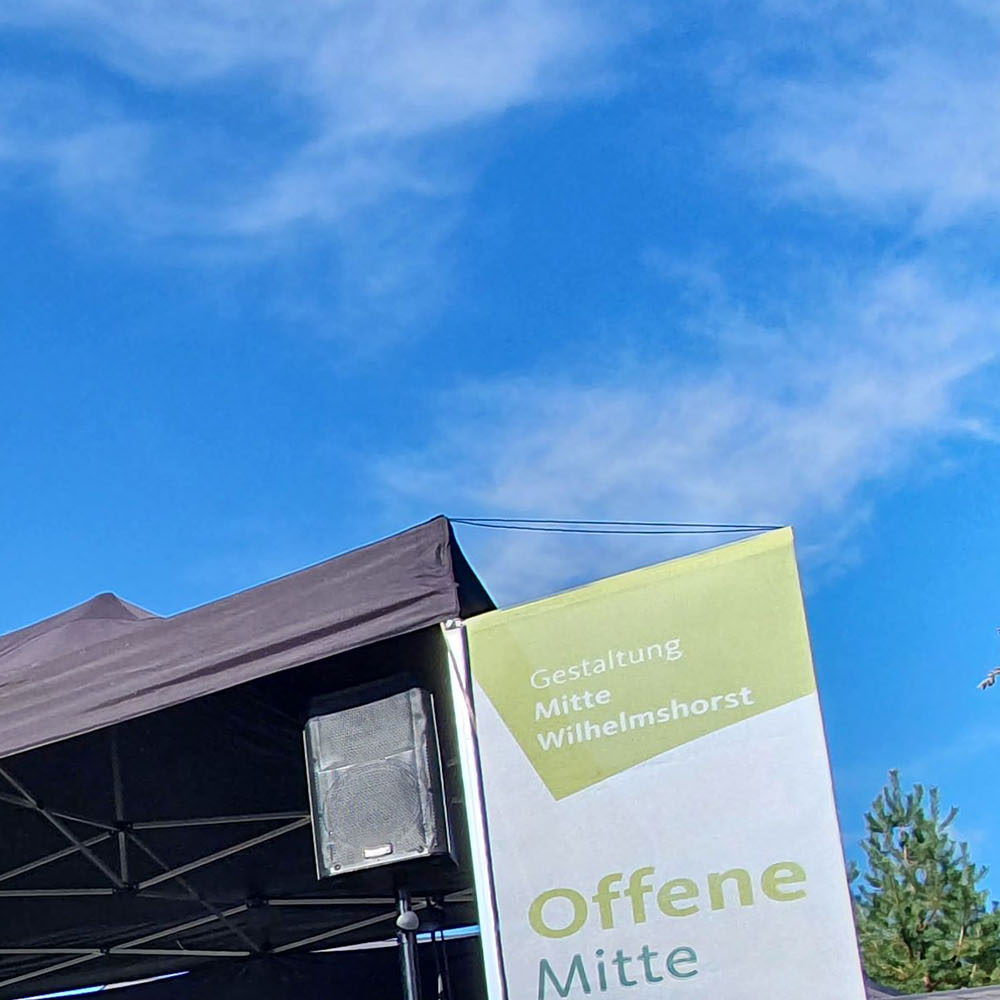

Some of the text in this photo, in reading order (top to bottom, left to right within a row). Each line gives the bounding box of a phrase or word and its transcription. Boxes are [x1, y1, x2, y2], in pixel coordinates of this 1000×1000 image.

[530, 637, 683, 689] Gestaltung
[535, 688, 612, 721] Mitte
[536, 686, 755, 751] Wilhelmshorst
[528, 861, 807, 938] Offene
[538, 945, 699, 1000] Mitte
